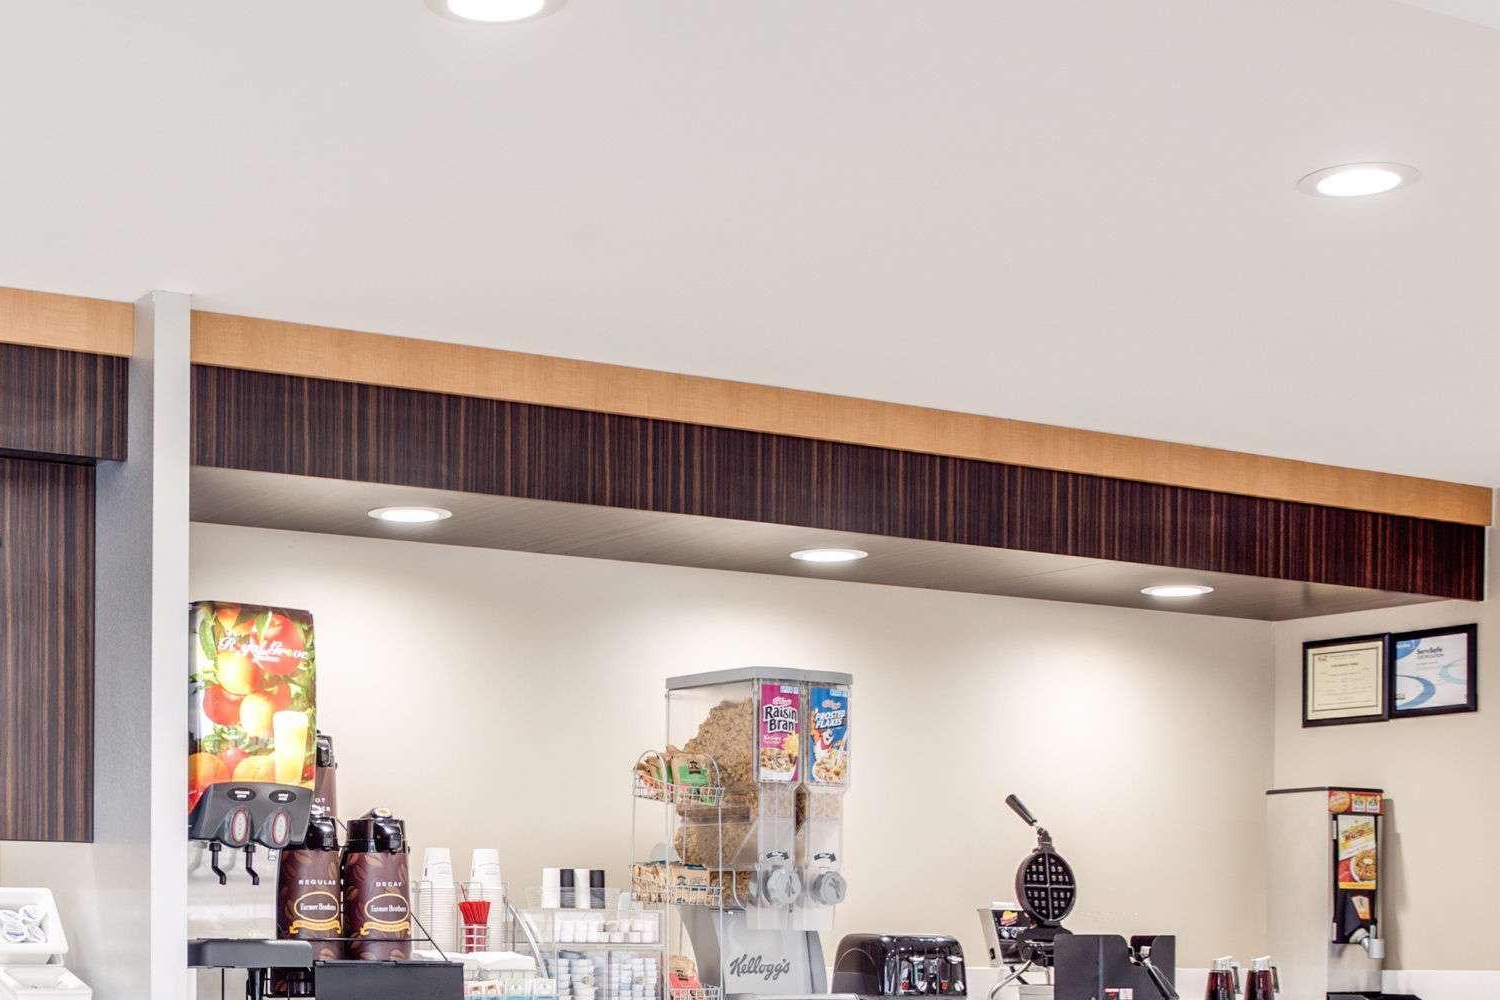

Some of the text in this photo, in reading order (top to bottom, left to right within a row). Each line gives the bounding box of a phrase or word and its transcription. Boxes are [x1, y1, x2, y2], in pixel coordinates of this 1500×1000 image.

[764, 705, 798, 722] Raisin
[768, 718, 795, 732] Bran
[375, 880, 403, 888] DECAF
[729, 951, 791, 982] Kellogg's
